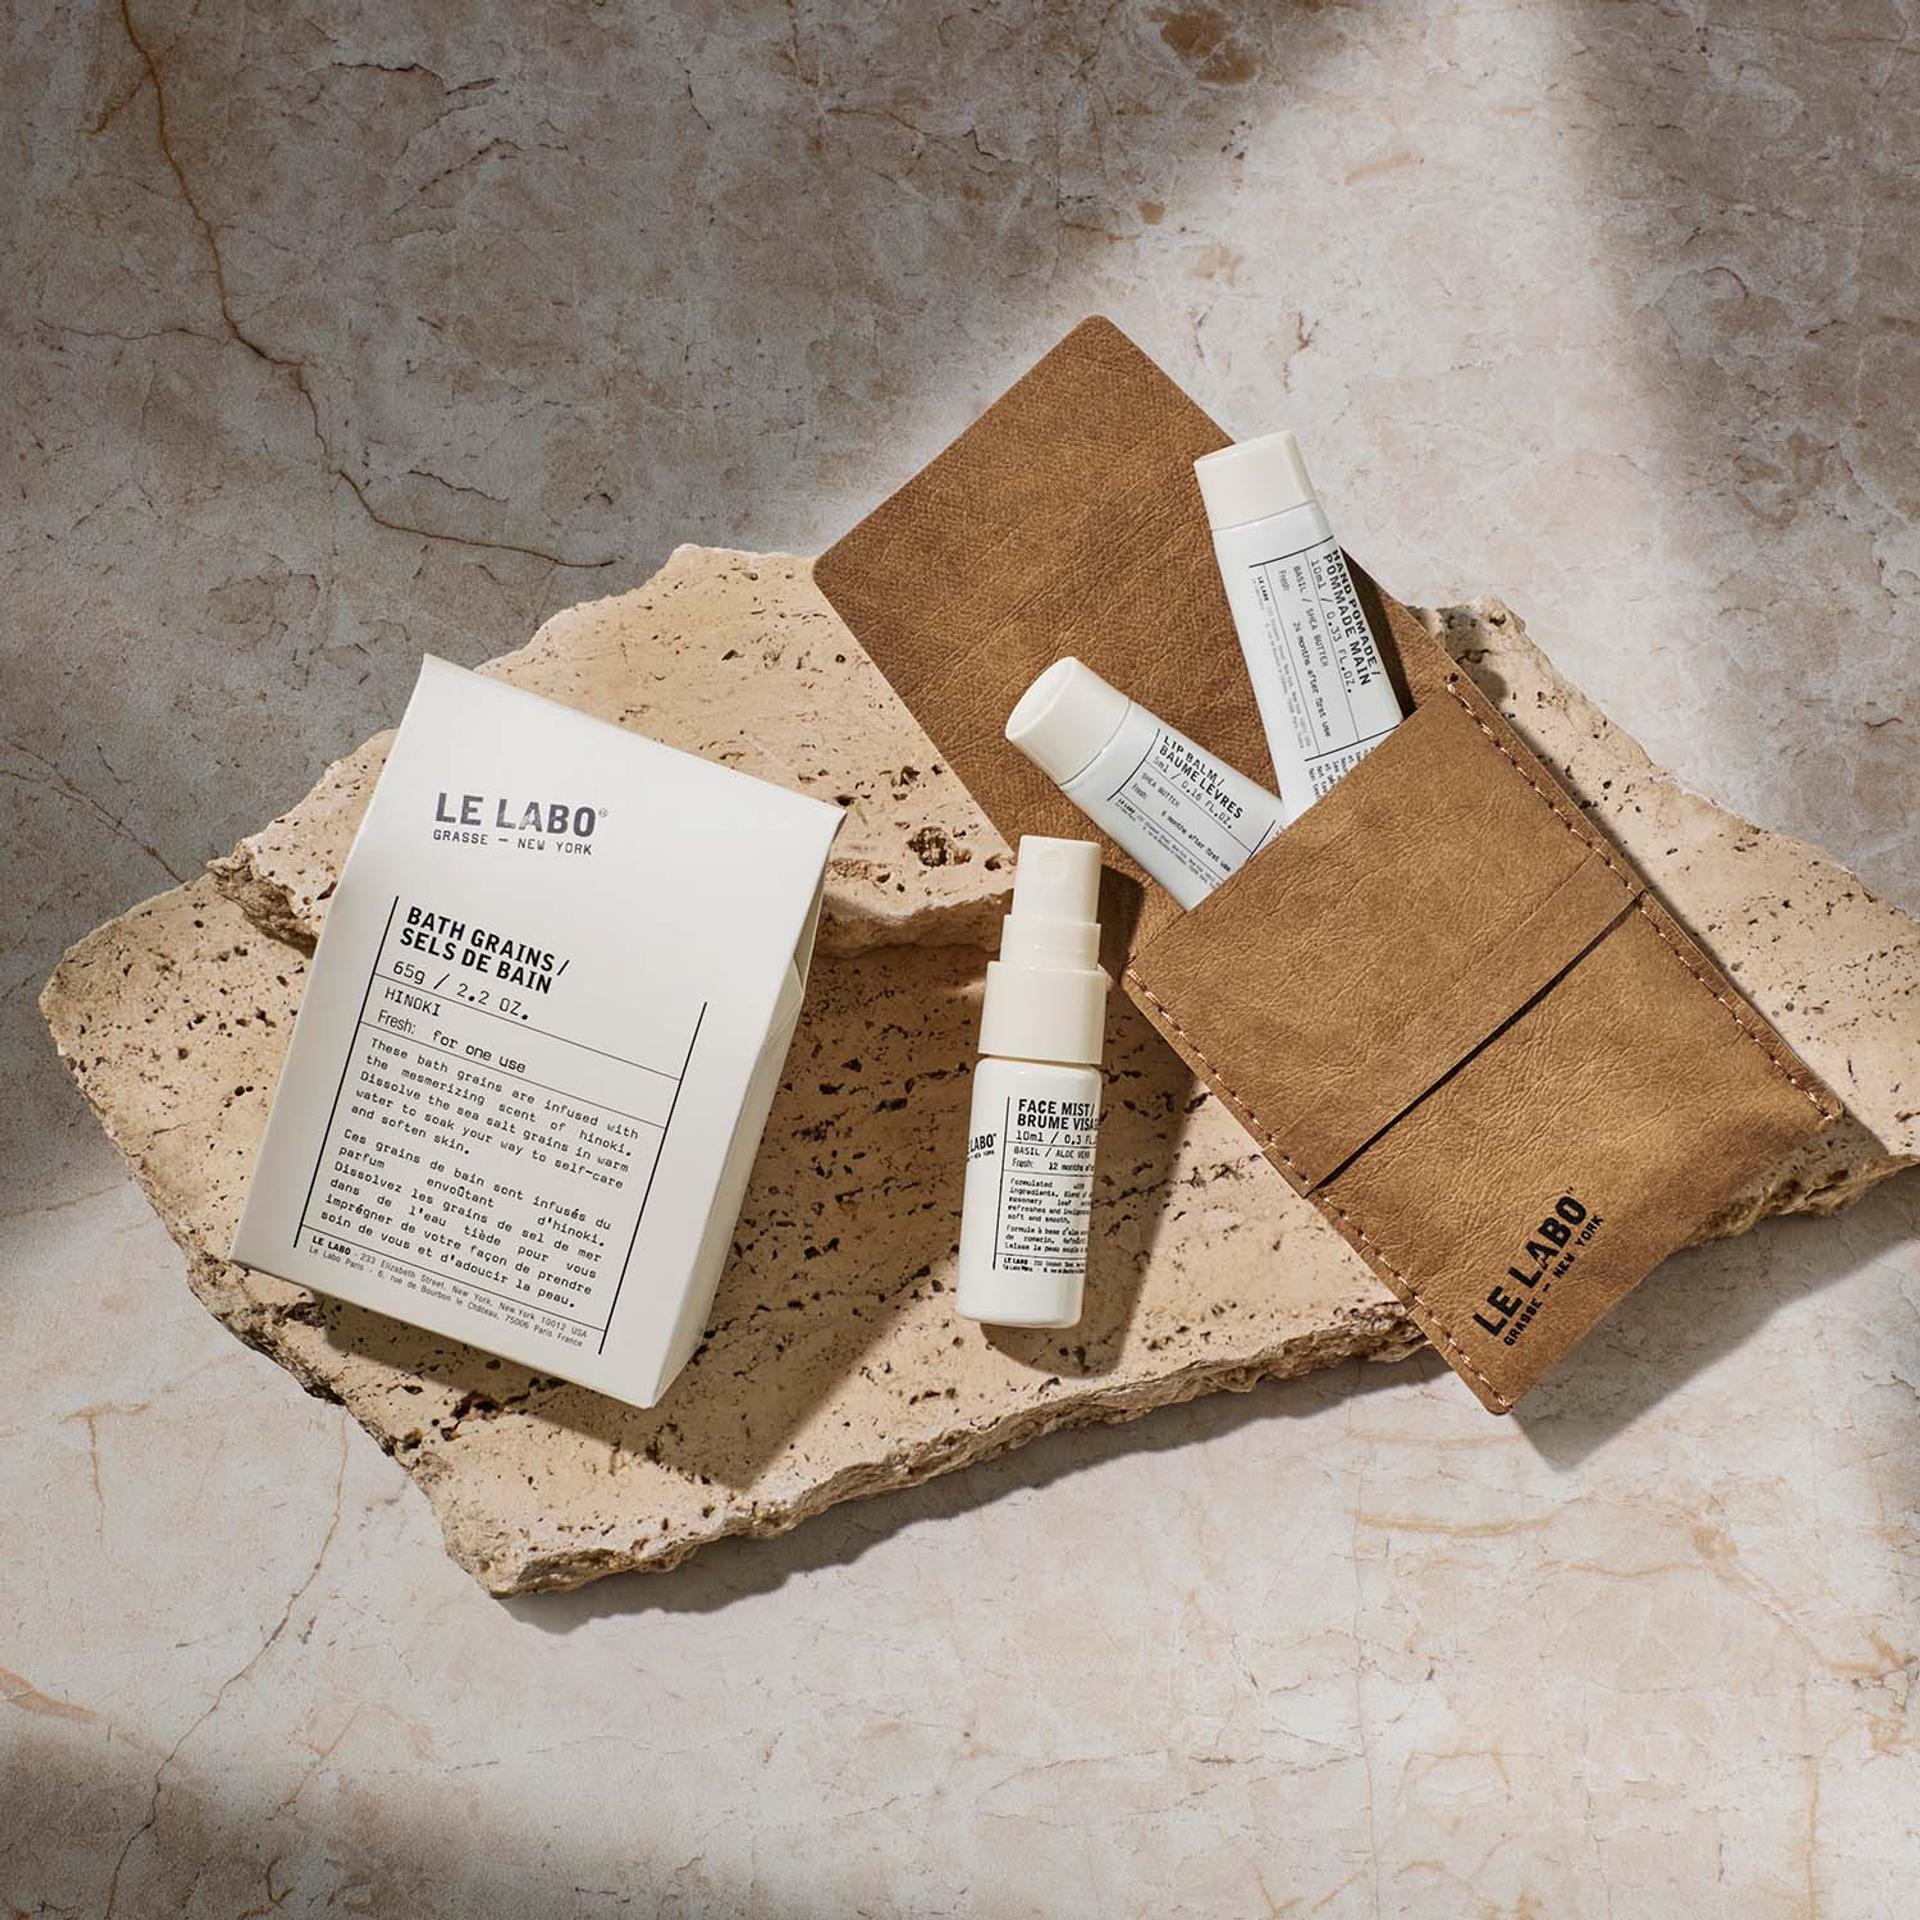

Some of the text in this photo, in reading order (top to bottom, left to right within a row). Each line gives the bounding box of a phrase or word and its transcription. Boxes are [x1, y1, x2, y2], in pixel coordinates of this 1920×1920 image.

[1310, 559, 1326, 590] 10ml
[1326, 611, 1342, 642] 0.33
[1323, 553, 1371, 685] POMMADE MAIN
[1332, 549, 1380, 675] HAND POMADE/
[1298, 635, 1310, 666] months
[1307, 670, 1319, 693] after
[1322, 721, 1331, 737] use
[1159, 745, 1243, 818] BAUME LEVRES
[1164, 735, 1224, 786] LIP BALM/
[433, 829, 488, 845] GRASSE
[517, 838, 545, 850] NEW
[556, 842, 592, 855] YORK
[436, 792, 483, 826] LE
[400, 927, 552, 994] SELS DE BAIN
[406, 906, 465, 941] BATH
[384, 986, 441, 1017] HINOKI
[393, 960, 425, 985] 65g
[456, 982, 490, 1005] 2.2
[499, 997, 528, 1020] OZ.
[377, 1008, 526, 1073] Fresh: for one use
[360, 1070, 628, 1172] Dissolve the sea salt grains in warm
[366, 1054, 631, 1156] the mesmerizing scent of hinoki.
[371, 1037, 638, 1139] These bath grains are infused with
[1017, 1113, 1069, 1130] BRUME
[1018, 1098, 1095, 1117] FACE MIST/
[351, 1105, 469, 1154] and soften skin.
[355, 1089, 623, 1189] water to soak your way to self-care
[1013, 1145, 1040, 1156] BASIL
[1016, 1130, 1081, 1145] 10ml 0.3
[1048, 1161, 1058, 1170] 12
[334, 1160, 602, 1262] Dissolvez les grains de sel de mer
[338, 1146, 604, 1247] parfum envoûtant d'hinoki.
[344, 1128, 611, 1230] Ces grains de bain sont infusés du
[321, 1211, 574, 1308] soin de vous et d'adoucir la peau.
[325, 1193, 592, 1294] imprégner de votre façon de prendre
[330, 1178, 596, 1278] dans de l'eau tiède pour vous
[312, 1235, 324, 1246] LE
[327, 1240, 351, 1255] LABO
[499, 1301, 515, 1313] New
[518, 1309, 534, 1320] York
[571, 1326, 587, 1338] USA
[1473, 1286, 1522, 1336] LE
[1503, 1297, 1543, 1346] GRASSE
[1552, 1252, 1575, 1279] NEW
[1574, 1214, 1604, 1247] YORK
